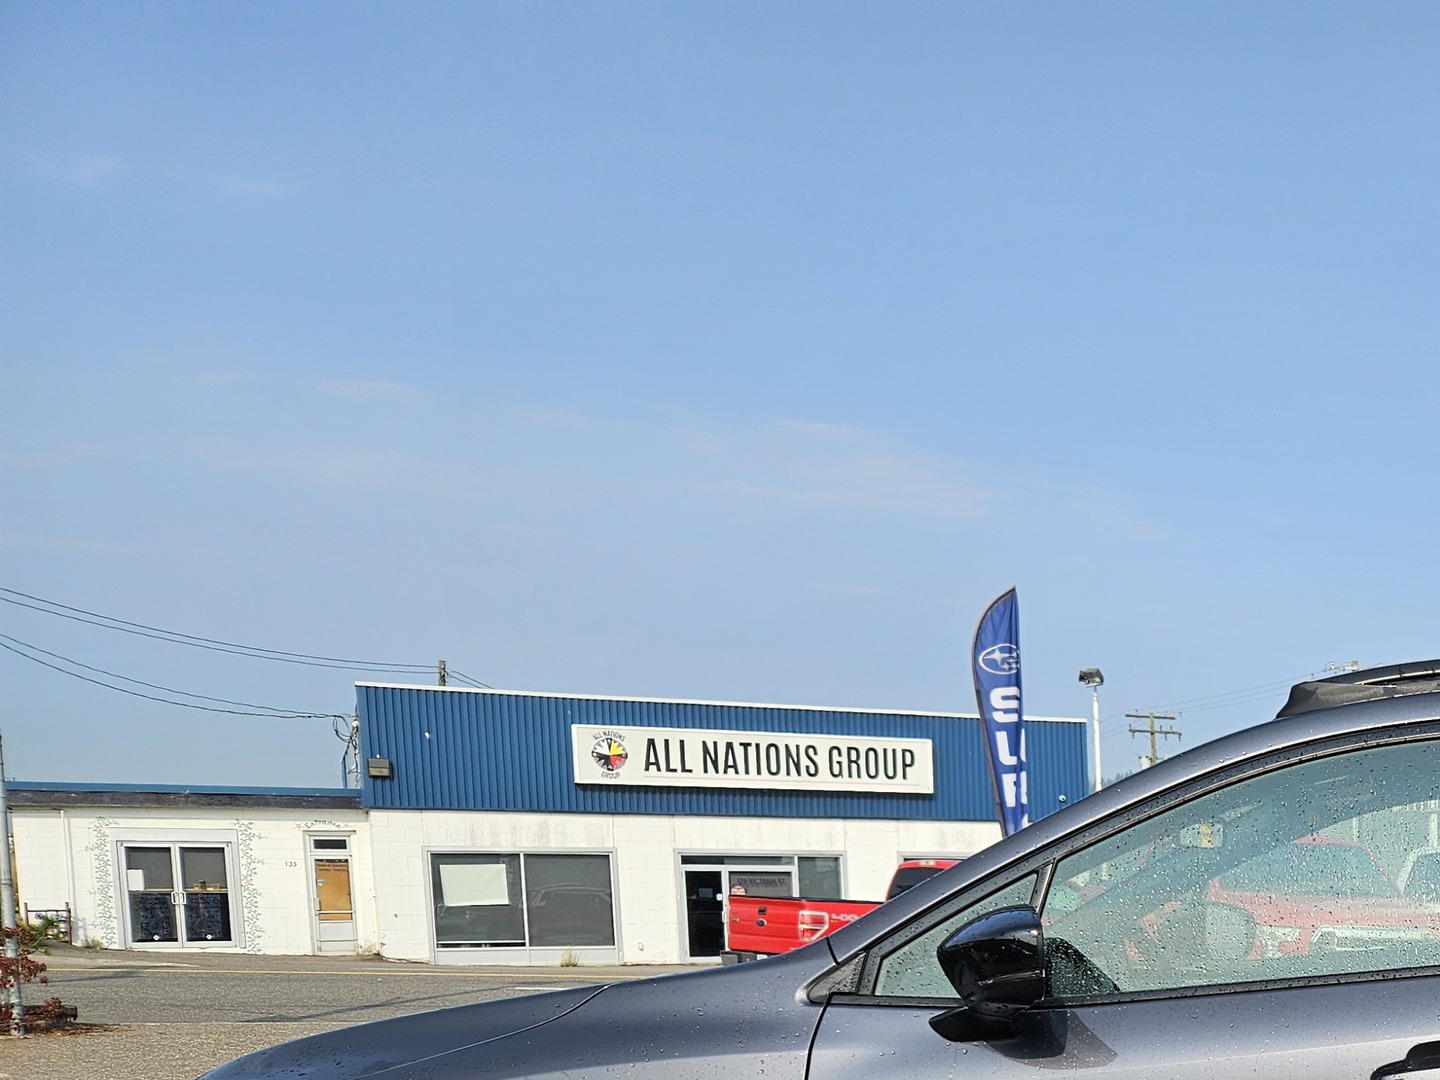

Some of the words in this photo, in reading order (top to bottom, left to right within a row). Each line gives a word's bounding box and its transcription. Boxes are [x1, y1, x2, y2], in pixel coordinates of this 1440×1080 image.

[644, 738, 693, 773] ALL
[702, 740, 819, 779] NATIONS
[828, 745, 915, 780] GROUP
